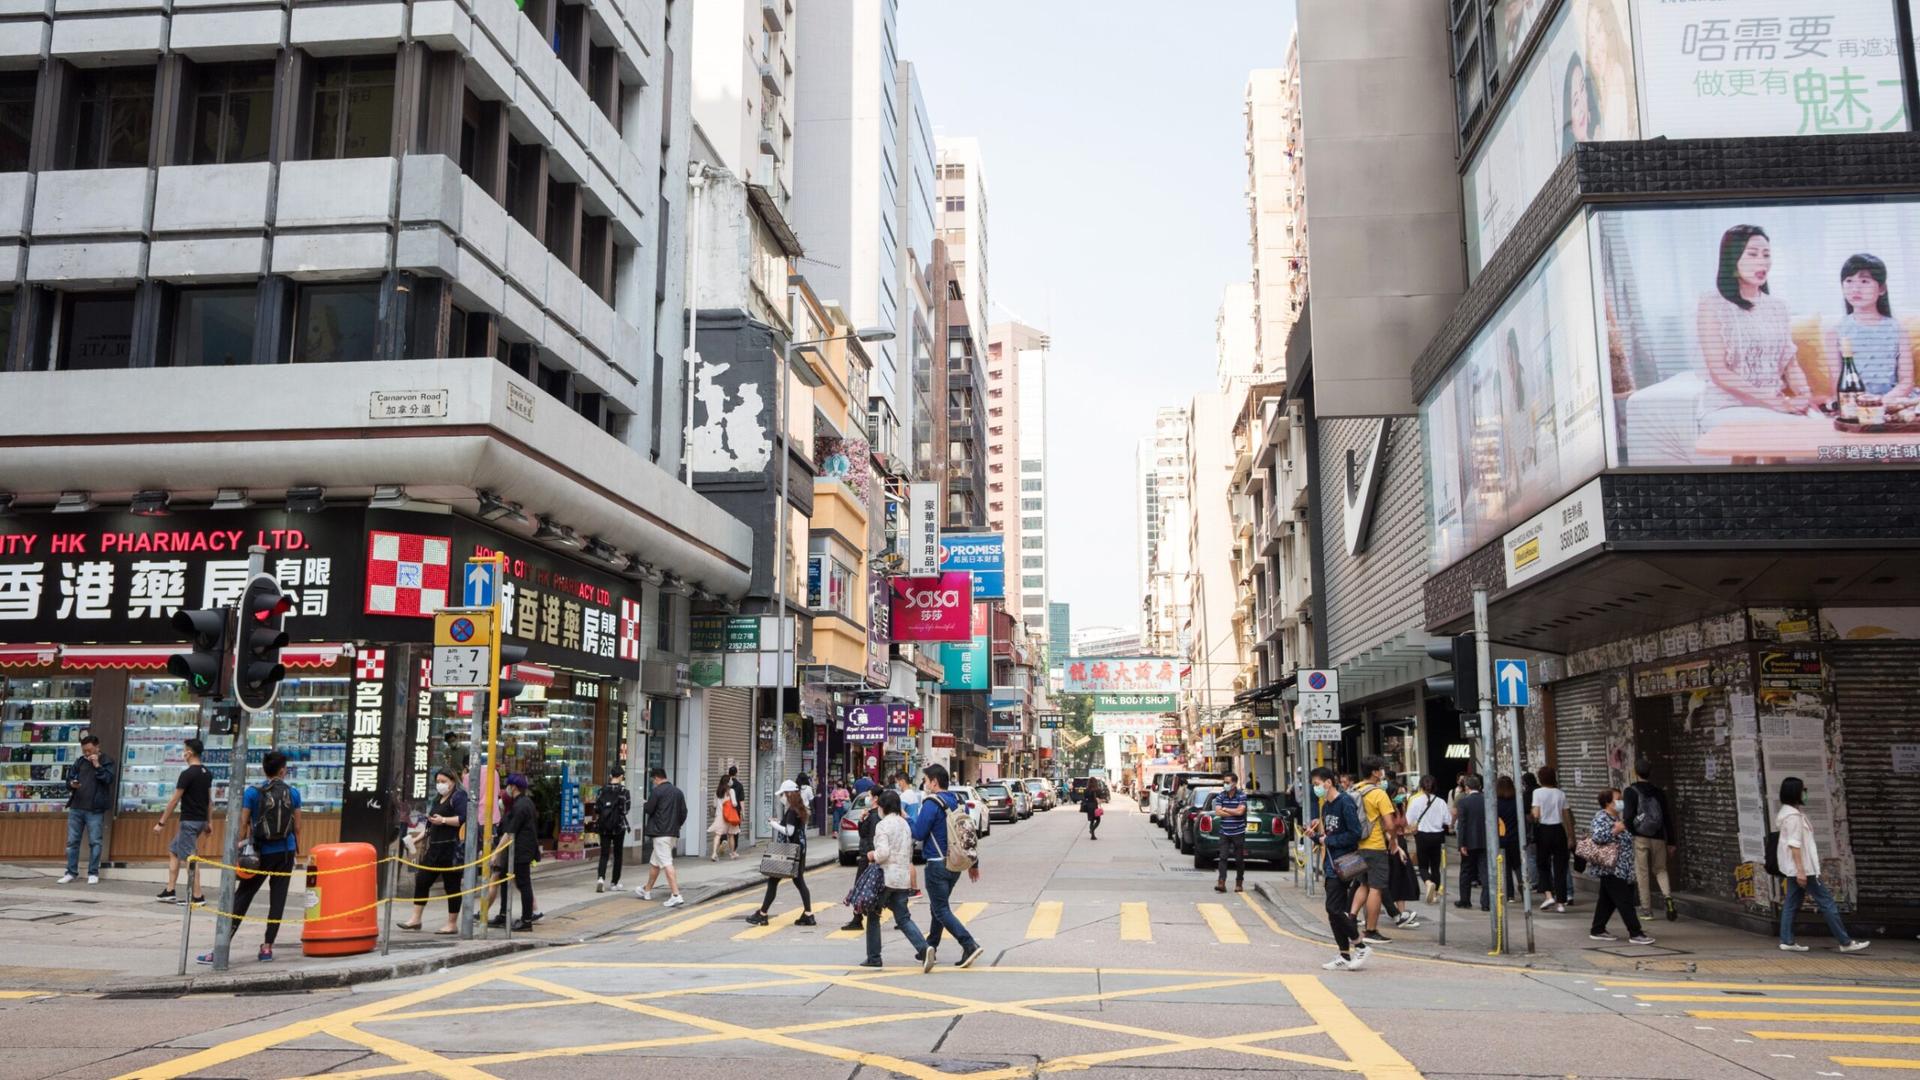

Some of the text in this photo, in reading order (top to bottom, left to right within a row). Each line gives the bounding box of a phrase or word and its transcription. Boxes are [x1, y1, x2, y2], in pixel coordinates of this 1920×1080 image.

[1682, 15, 1835, 61] 唔需要
[1693, 67, 1790, 97] 做更有
[420, 392, 441, 401] Road
[1818, 445, 1920, 460] 只不過是想生頭
[51, 533, 87, 553] HK
[100, 530, 243, 552] PHARMACY
[257, 529, 311, 550] LTD.
[950, 545, 1001, 556] PROMISE
[275, 557, 331, 586] 有限
[0, 559, 250, 620] 香港藥房
[921, 609, 942, 621] 莎莎
[470, 649, 479, 662] 7
[469, 670, 478, 683] 7
[1100, 696, 1169, 705] THE BODY SHOP
[1324, 694, 1331, 704] 7
[1325, 709, 1332, 719] 7
[350, 681, 383, 793] 名城藥房
[413, 690, 432, 799] 名城藥房
